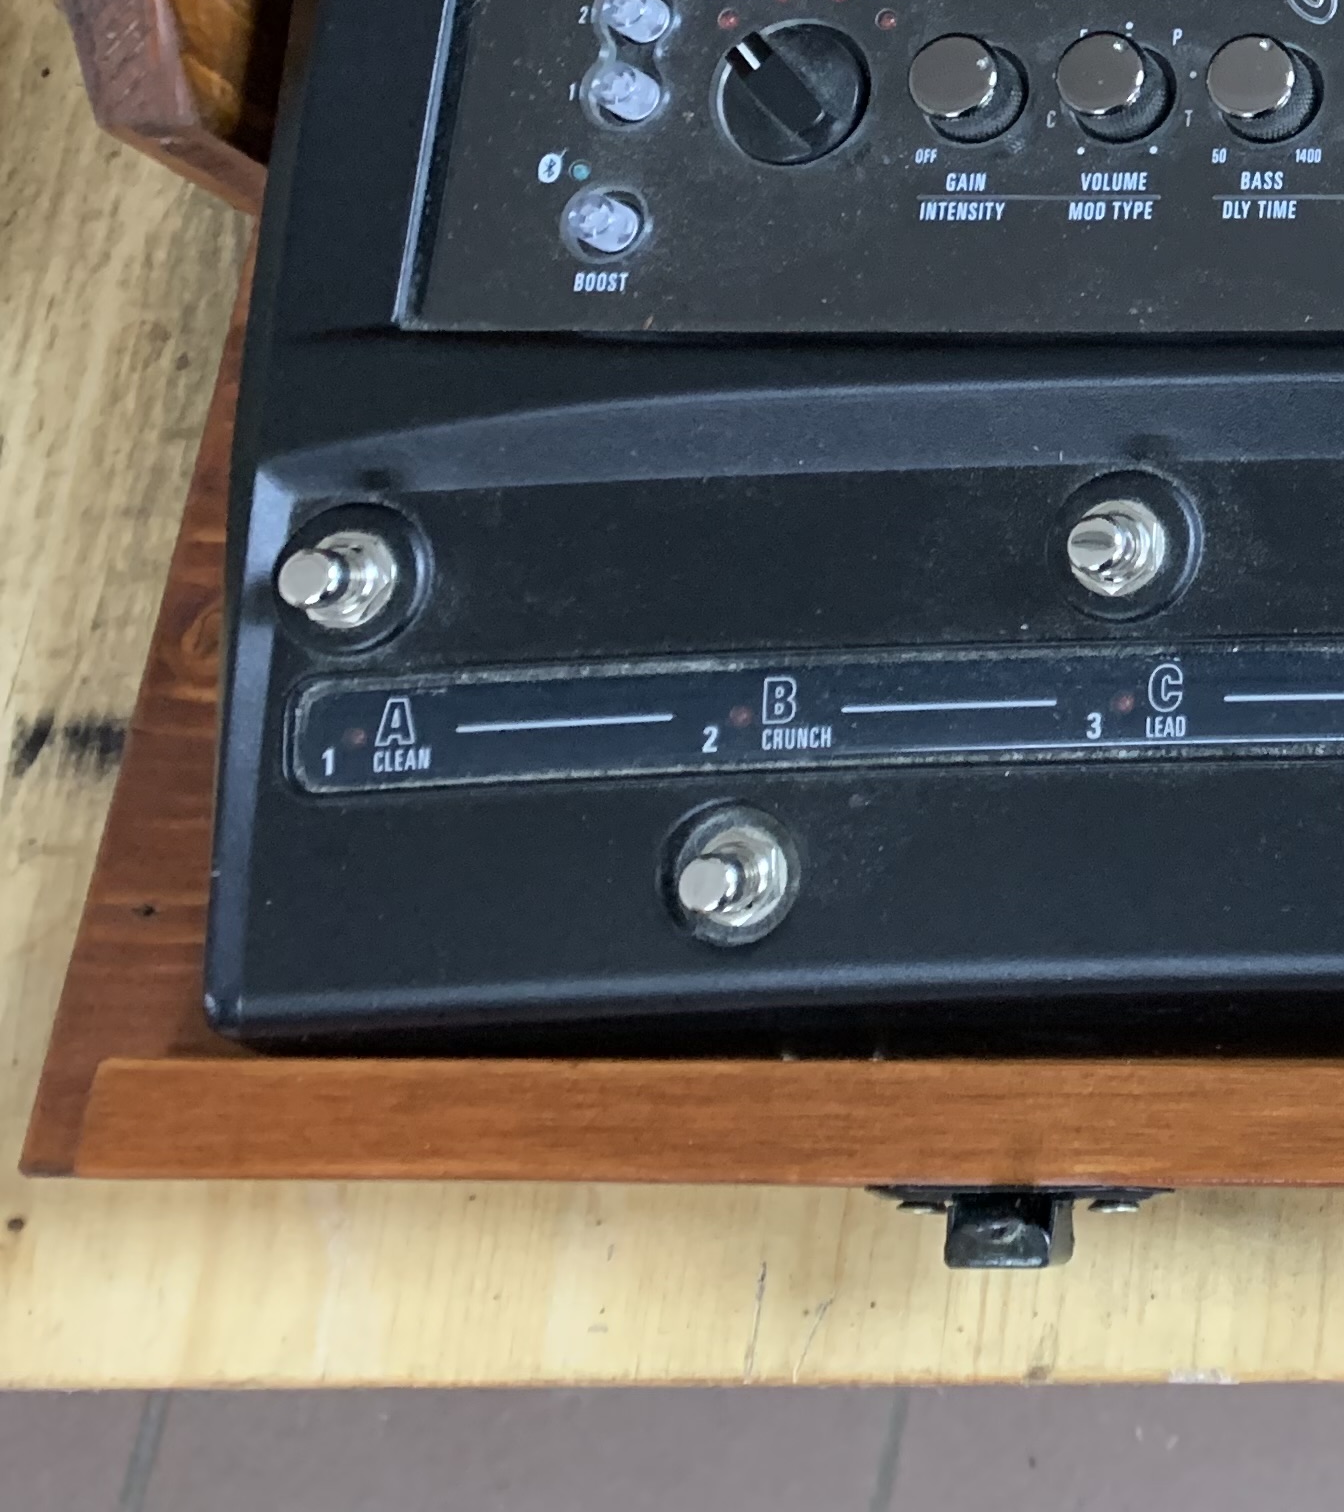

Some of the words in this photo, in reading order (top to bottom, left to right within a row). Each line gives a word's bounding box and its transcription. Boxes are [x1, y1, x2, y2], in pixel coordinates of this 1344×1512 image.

[914, 148, 939, 165] OFF
[1211, 147, 1228, 165] 50
[1294, 147, 1323, 165] 1400
[945, 171, 988, 192] GAIN
[1079, 171, 1149, 192] VOLUME
[1239, 170, 1285, 191] BASS
[918, 200, 1006, 222] INTENSITY
[1067, 200, 1107, 221] MOD
[1111, 200, 1155, 221] TYPE
[1221, 199, 1252, 220] DLY
[1256, 199, 1298, 220] TIME
[572, 272, 630, 293] BOOST
[1146, 662, 1185, 713] C
[761, 675, 798, 726] B
[374, 697, 415, 747] A
[1085, 712, 1102, 741] 3
[1144, 715, 1187, 740] LEAD
[700, 725, 720, 754] 2
[760, 726, 833, 752] CRUNCH
[320, 747, 336, 777] 1
[372, 746, 432, 774] CLEAN
